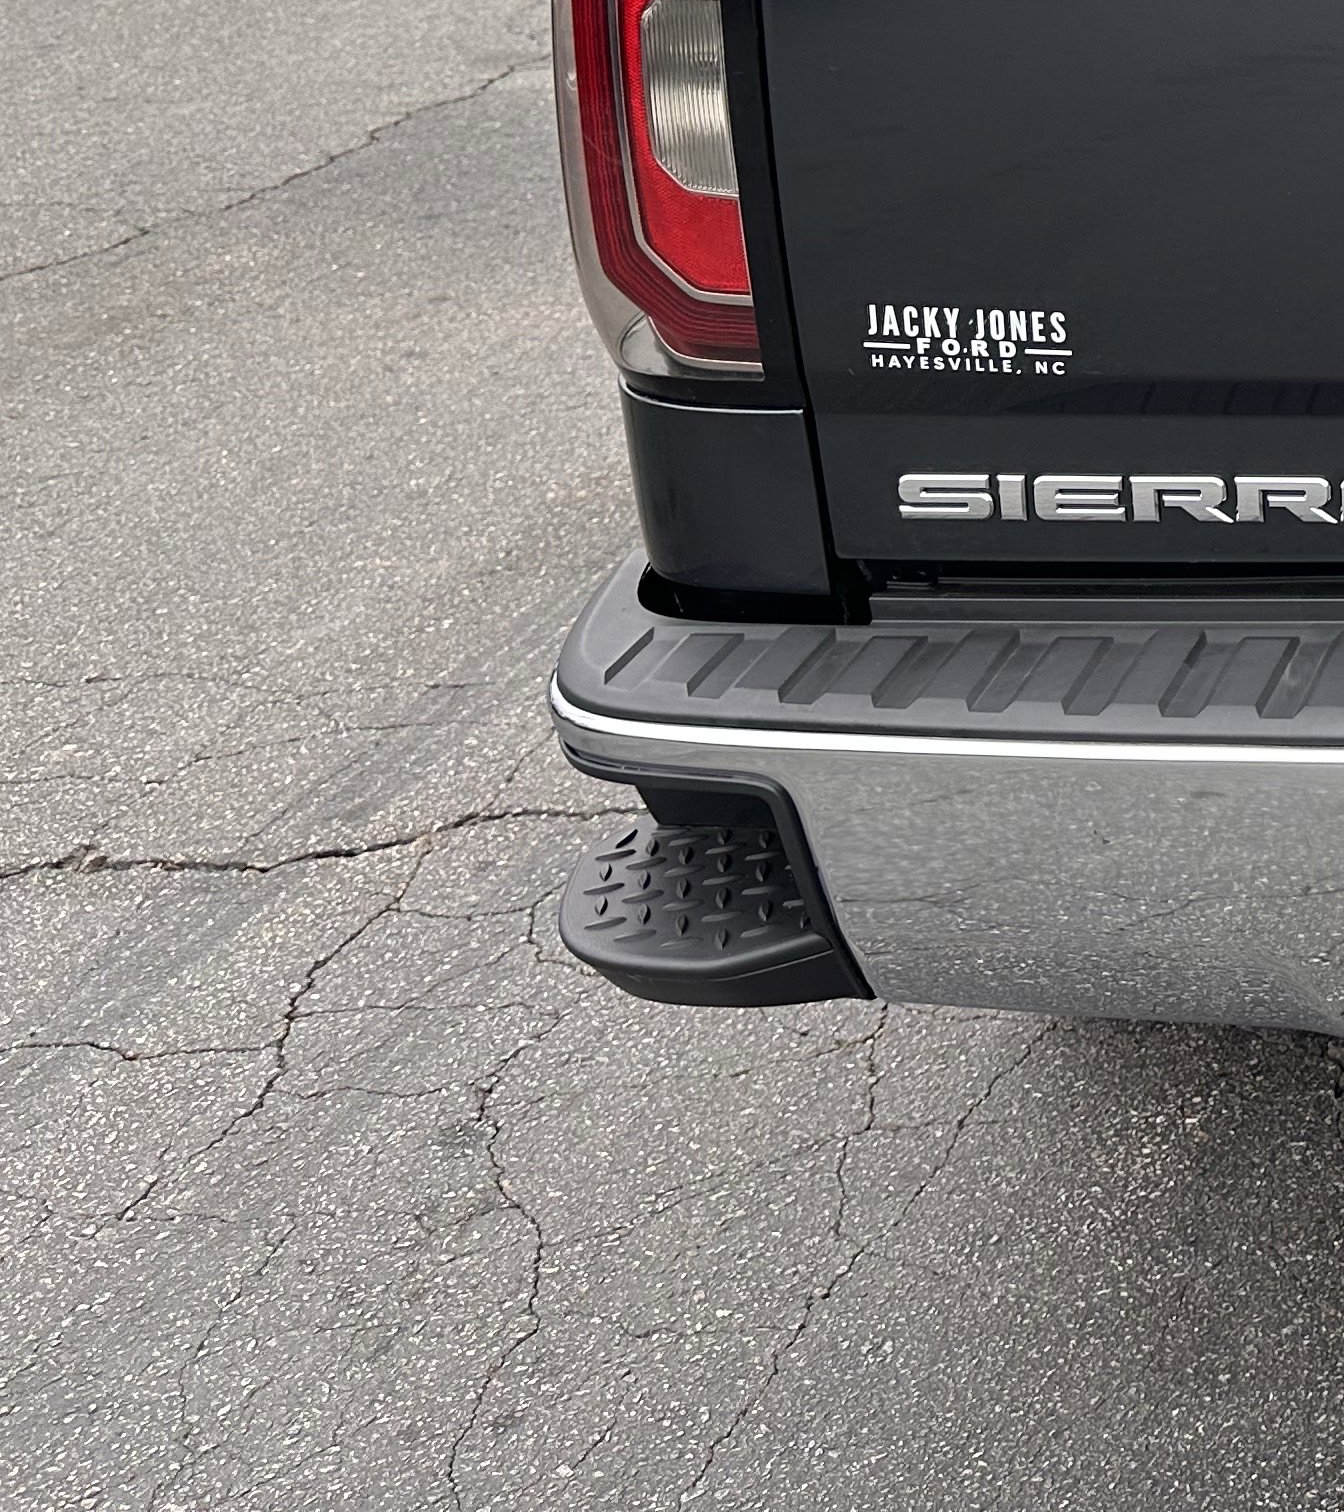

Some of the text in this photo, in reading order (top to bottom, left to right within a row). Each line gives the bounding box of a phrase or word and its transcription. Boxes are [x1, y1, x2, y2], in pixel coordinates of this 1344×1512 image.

[867, 304, 1067, 344] JACKY JONES
[916, 337, 1017, 358] FORD
[871, 354, 1066, 376] HAYESVILLE, NC
